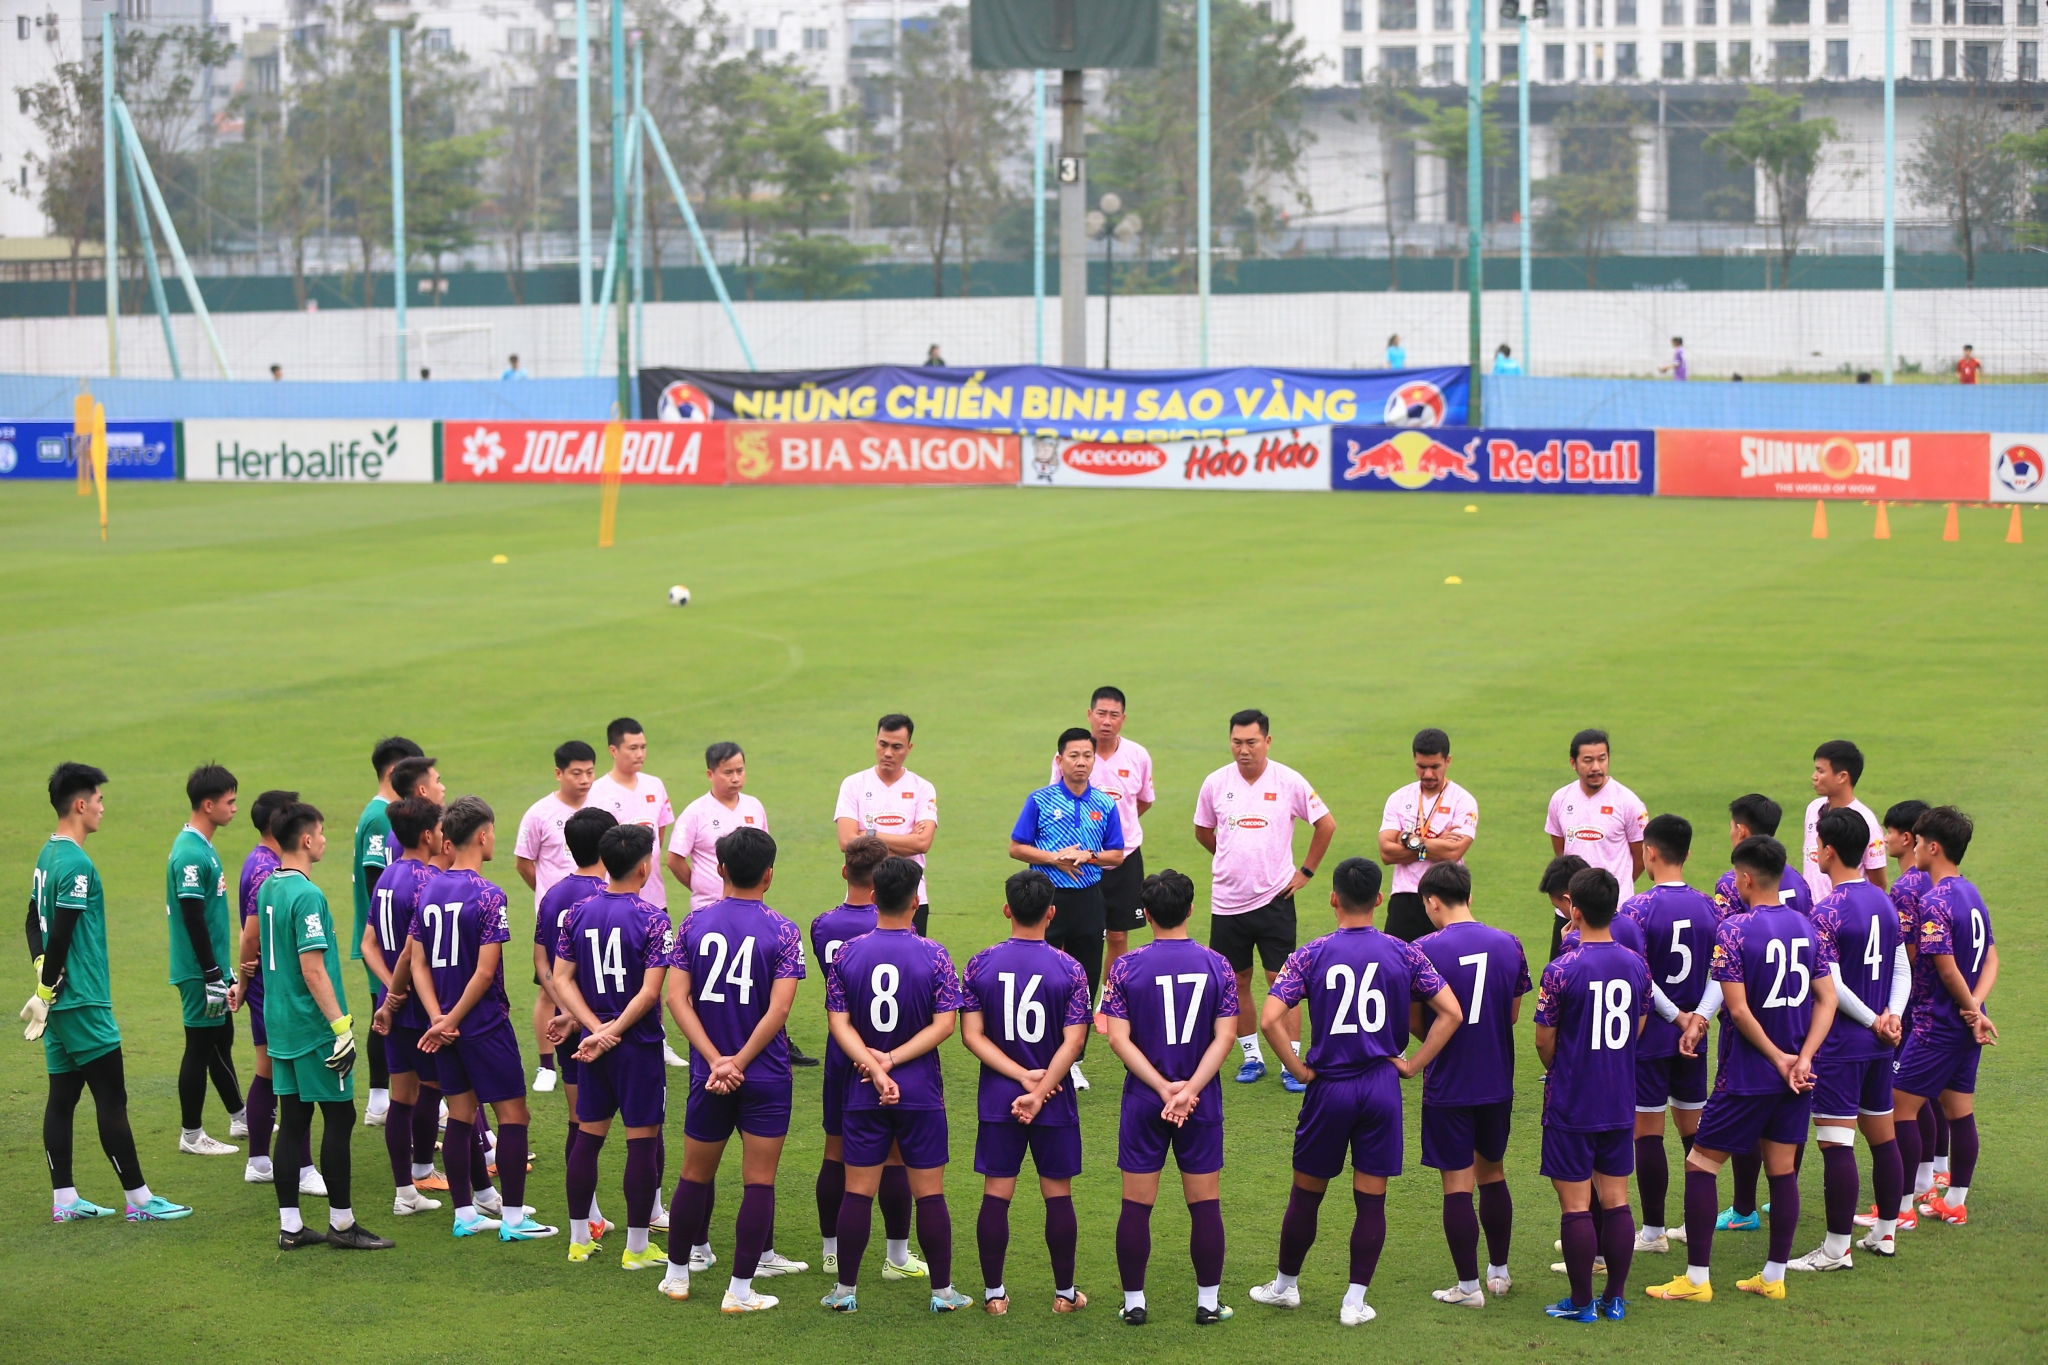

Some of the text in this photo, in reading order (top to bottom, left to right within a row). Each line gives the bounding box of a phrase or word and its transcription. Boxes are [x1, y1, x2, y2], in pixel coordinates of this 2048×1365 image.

[1060, 160, 1077, 182] 3
[885, 370, 1013, 420] CHIẾN
[1021, 385, 1126, 421] BINH
[1133, 387, 1224, 421] SAO
[1234, 378, 1357, 422] VÀNG
[217, 440, 383, 479] Herbalife
[512, 430, 702, 475] JOGABOLA
[781, 436, 1006, 472] BIA SAIGON
[1486, 439, 1642, 484] Red Bull
[1775, 483, 1876, 494] THE WORLD OF WOW
[266, 905, 276, 971] 1
[377, 888, 396, 952] 11
[423, 902, 464, 969] 27
[1665, 918, 1692, 984] 5
[1863, 914, 1883, 981] 4
[1971, 907, 1986, 973] 9
[585, 927, 627, 994] 14
[699, 932, 756, 1005] 24
[1458, 952, 1488, 1025] 7
[1762, 937, 1810, 1009] 25
[870, 963, 900, 1033] 8
[998, 971, 1046, 1044] 16
[1155, 973, 1208, 1045] 17
[1325, 962, 1386, 1036] 26
[1589, 978, 1632, 1051] 18
